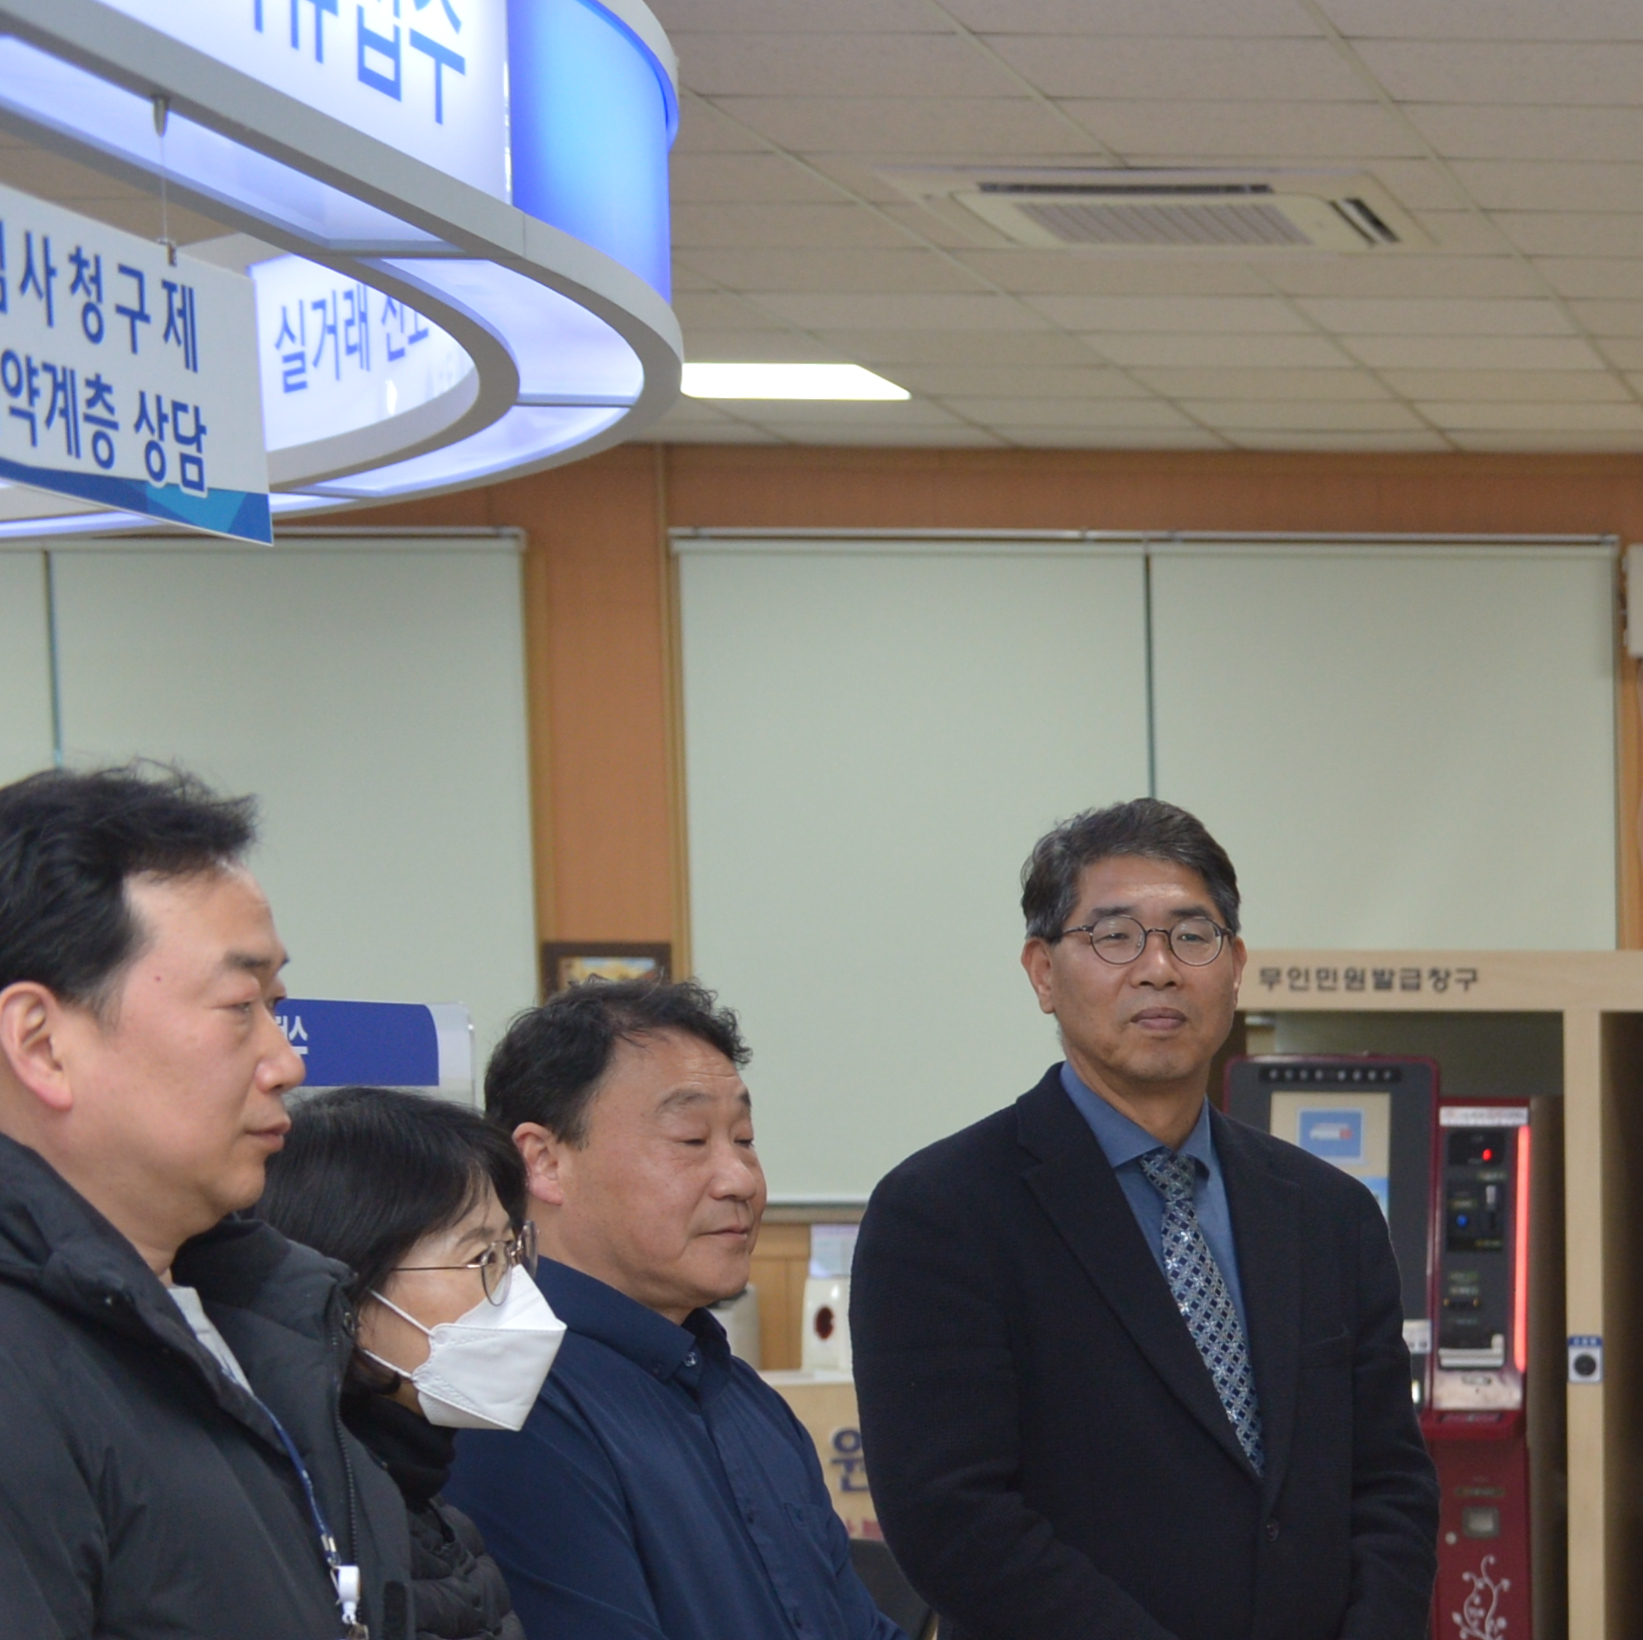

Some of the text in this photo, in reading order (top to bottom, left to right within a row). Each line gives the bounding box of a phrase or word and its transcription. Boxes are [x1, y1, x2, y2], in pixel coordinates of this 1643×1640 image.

[274, 283, 371, 394] 실거래
[133, 389, 208, 494] 상담
[1259, 966, 1479, 992] 무인민원발급창구
